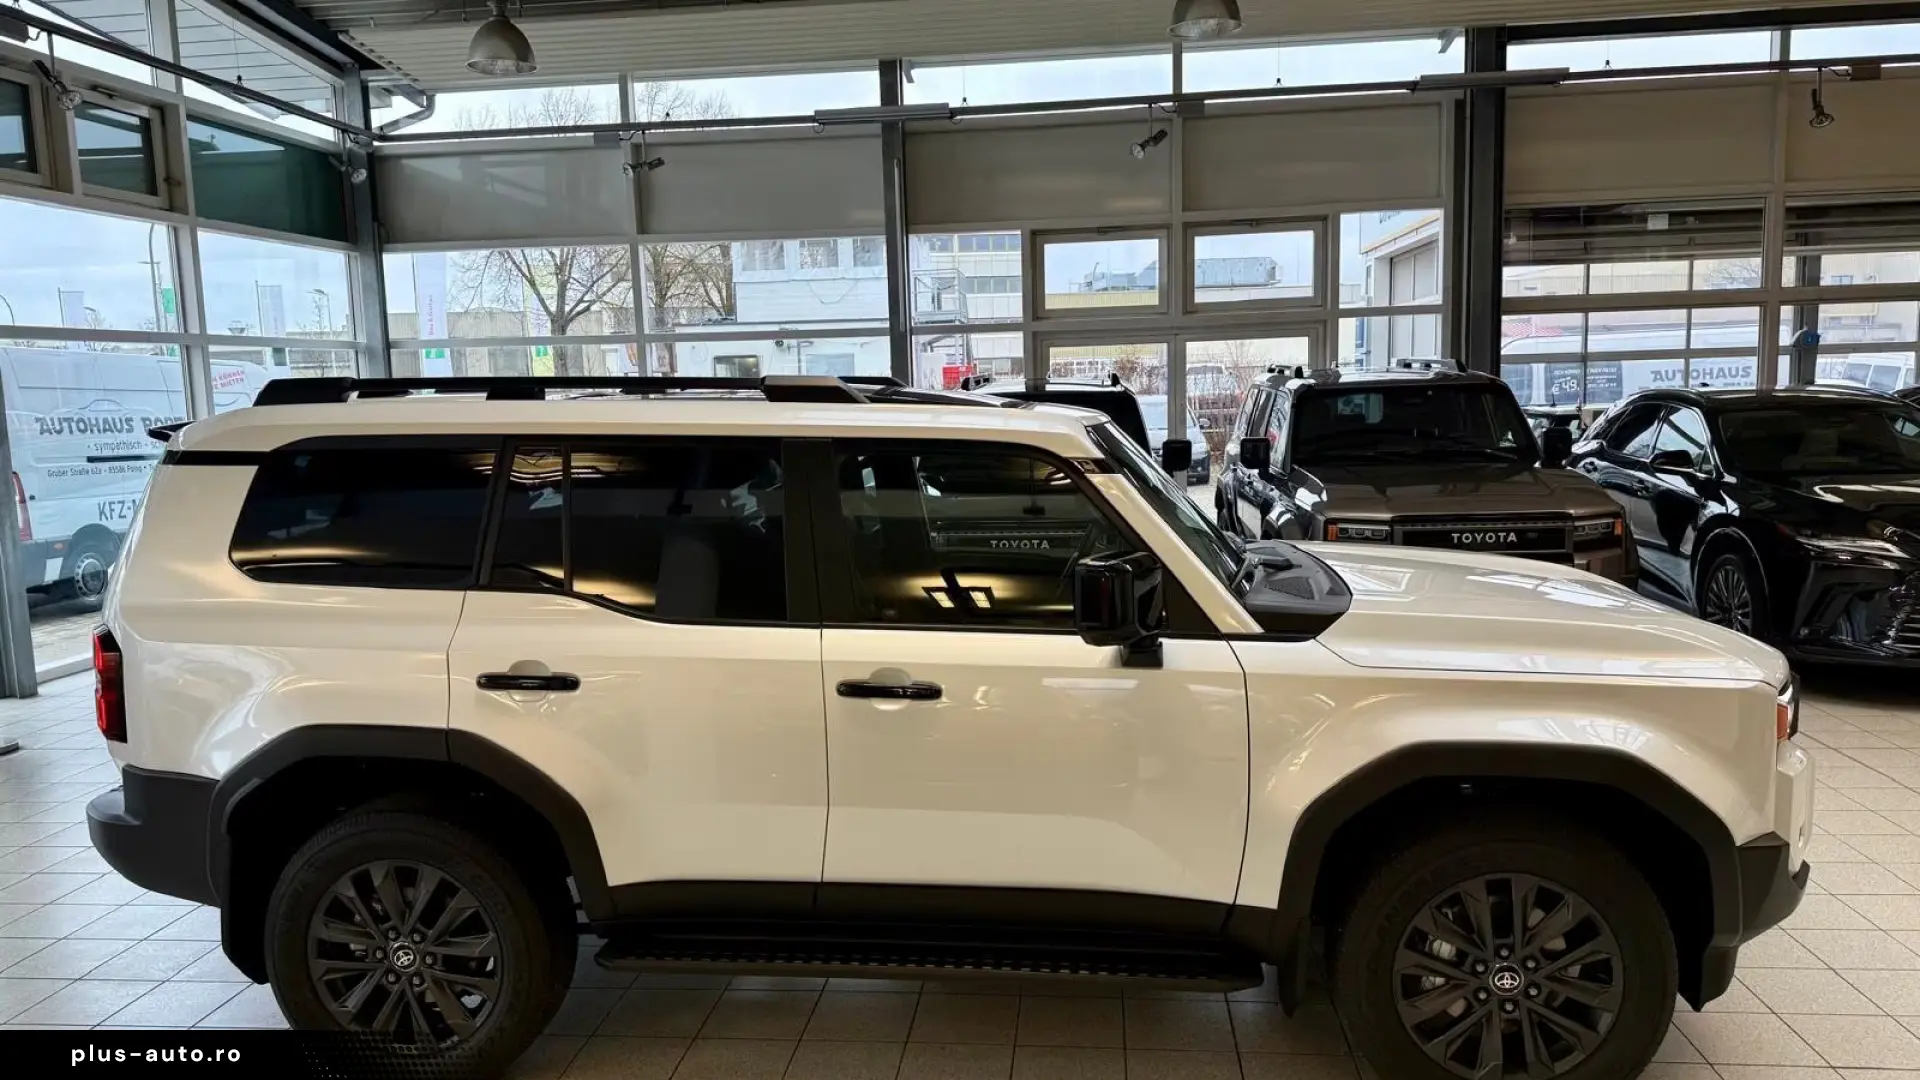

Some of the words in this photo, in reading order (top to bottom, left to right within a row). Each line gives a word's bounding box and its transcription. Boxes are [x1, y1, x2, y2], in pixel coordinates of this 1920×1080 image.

[1651, 366, 1753, 383] AUTOHAUS
[35, 416, 134, 436] AUTOHAUS
[94, 440, 143, 455] sympathisch
[70, 467, 90, 477] Straße
[989, 540, 1050, 549] TOYOTA
[1451, 533, 1518, 544] TOYOTA
